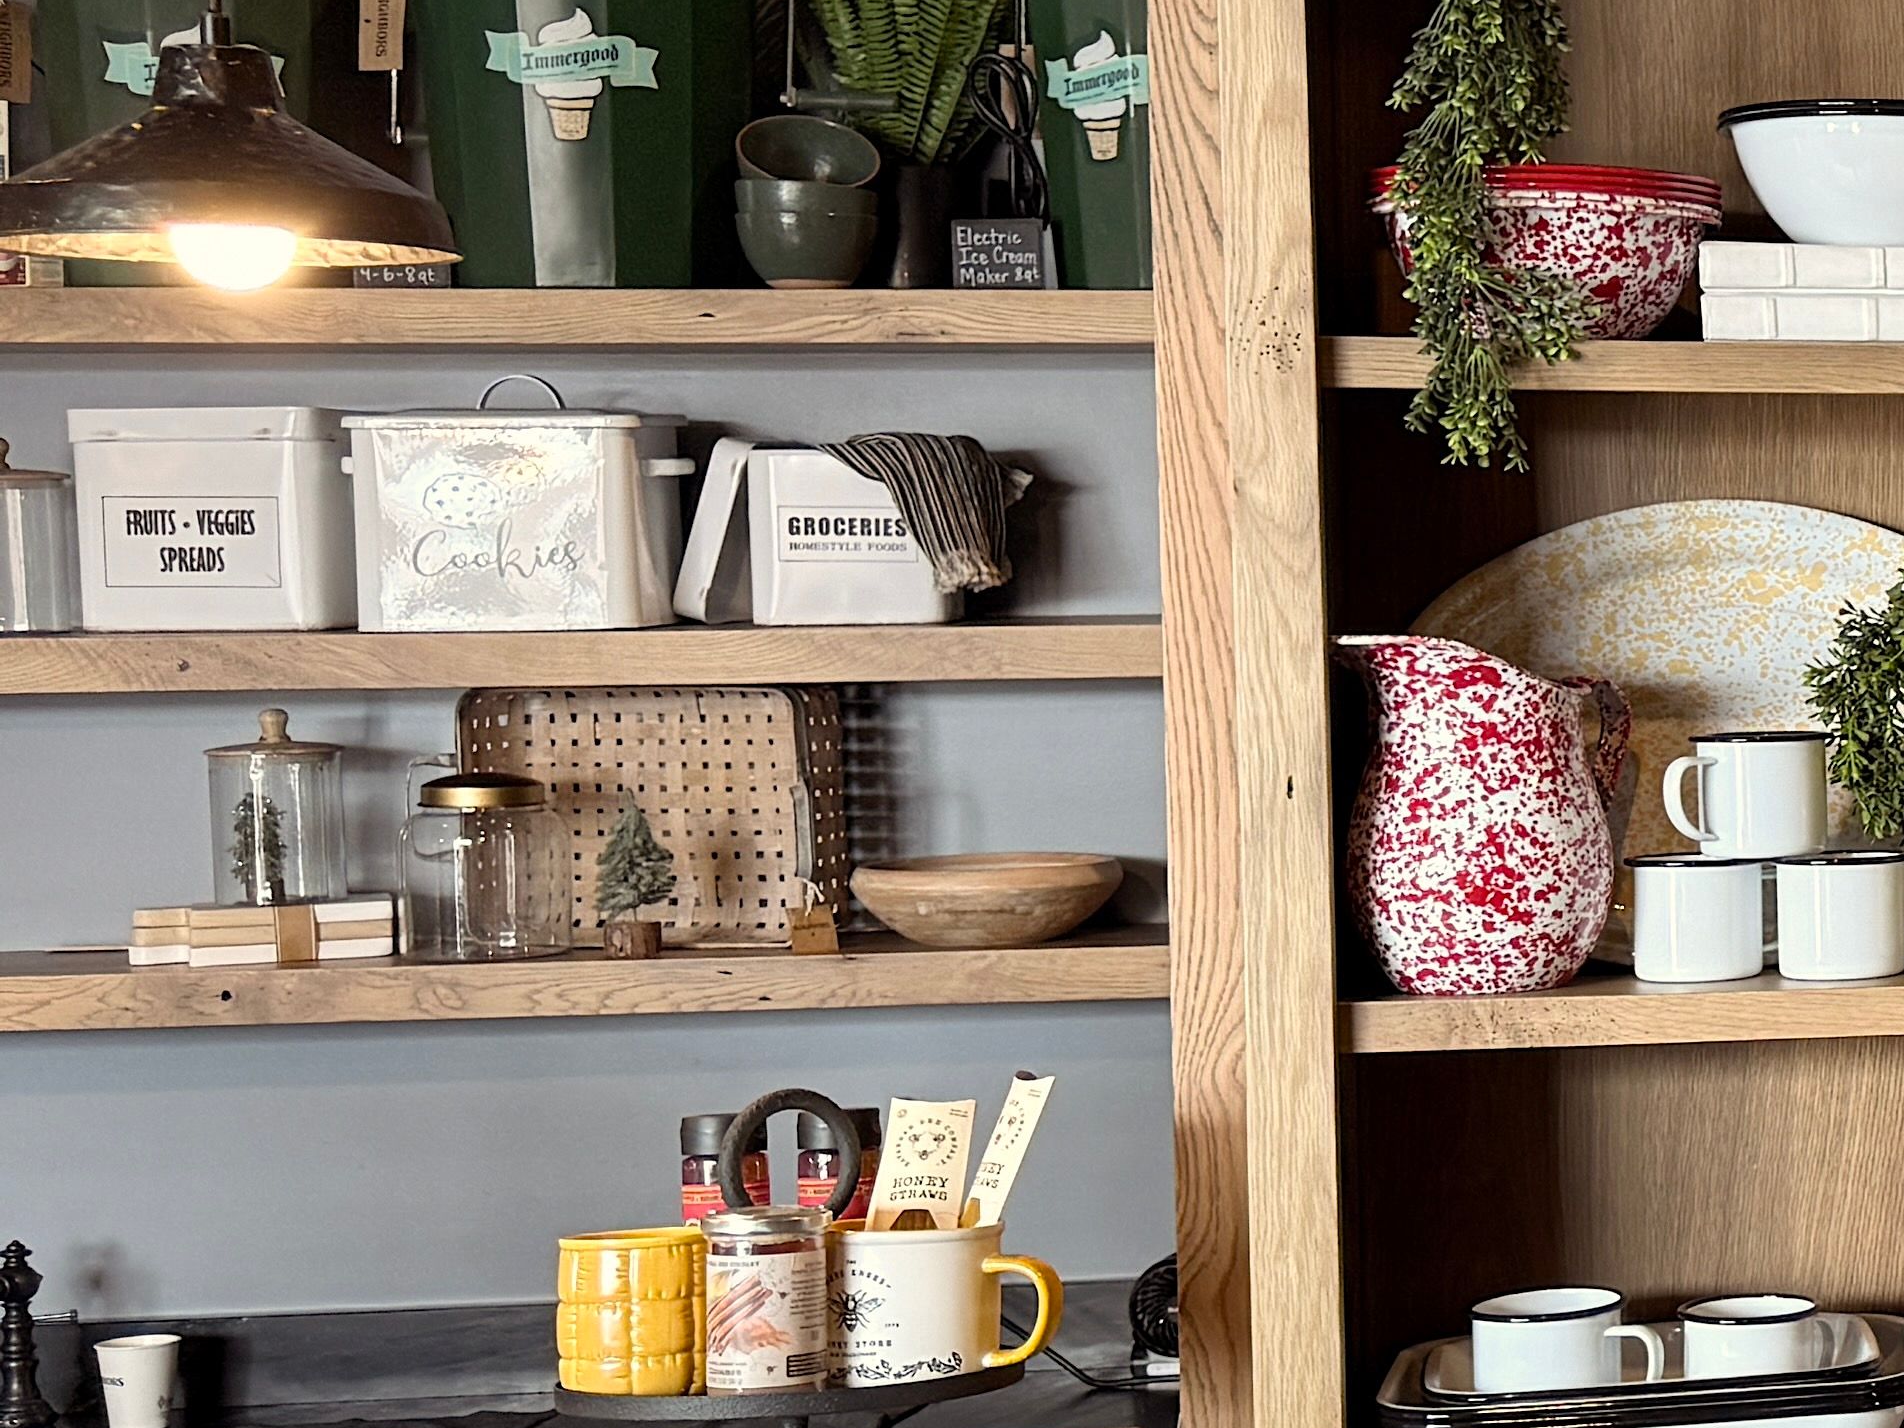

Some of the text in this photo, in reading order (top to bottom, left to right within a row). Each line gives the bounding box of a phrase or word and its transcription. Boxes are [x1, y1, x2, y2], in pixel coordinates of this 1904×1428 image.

[522, 44, 619, 70] Immergood
[1064, 63, 1139, 95] Immergood
[957, 226, 1021, 246] Electric
[959, 246, 1037, 266] Ice Cream
[960, 268, 1009, 287] Maker
[126, 509, 255, 536] FRUITS VEGGIES
[788, 516, 907, 537] GROCERIES
[412, 517, 585, 579] Cookies
[789, 542, 907, 552] HOMESTYLE FOODS
[160, 546, 225, 573] SPREADS
[893, 1175, 949, 1189] HONEY
[890, 1190, 947, 1201] STRAWS
